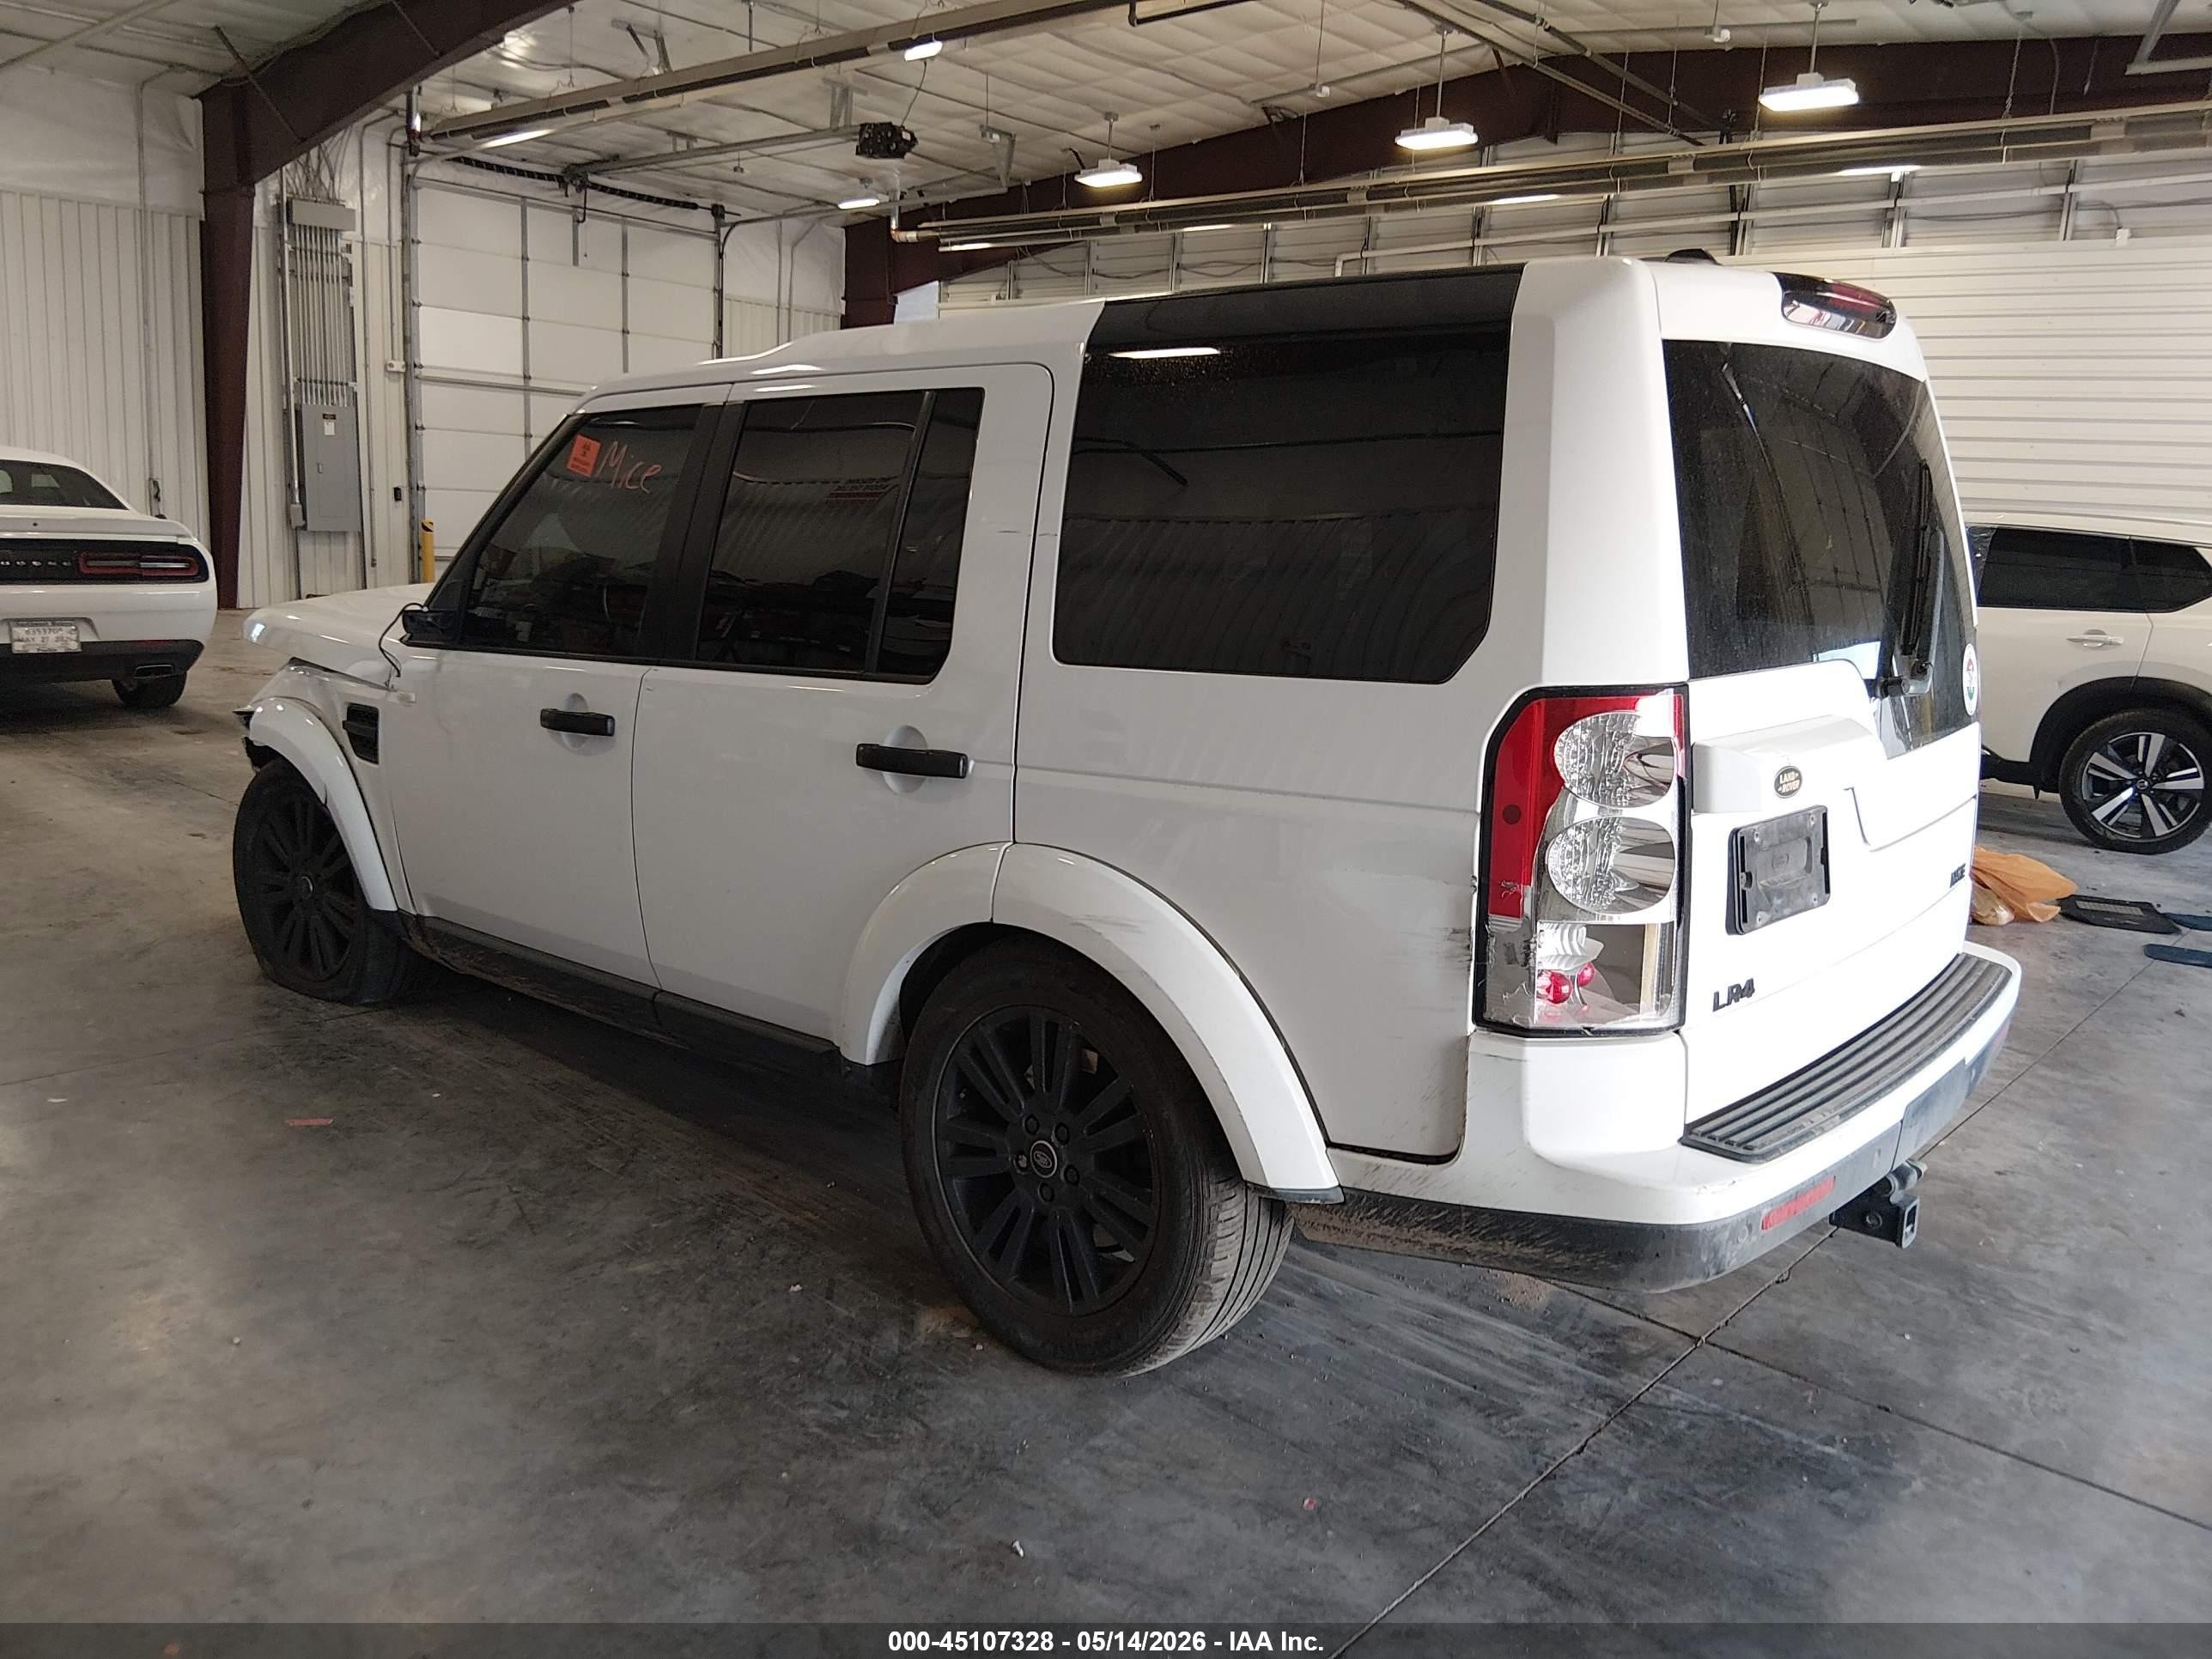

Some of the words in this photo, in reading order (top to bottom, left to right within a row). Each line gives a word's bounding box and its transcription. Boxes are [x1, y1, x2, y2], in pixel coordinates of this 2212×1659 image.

[1779, 771, 1796, 785] LAND
[1781, 779, 1801, 793] ROVER
[1712, 977, 1755, 1012] LR4
